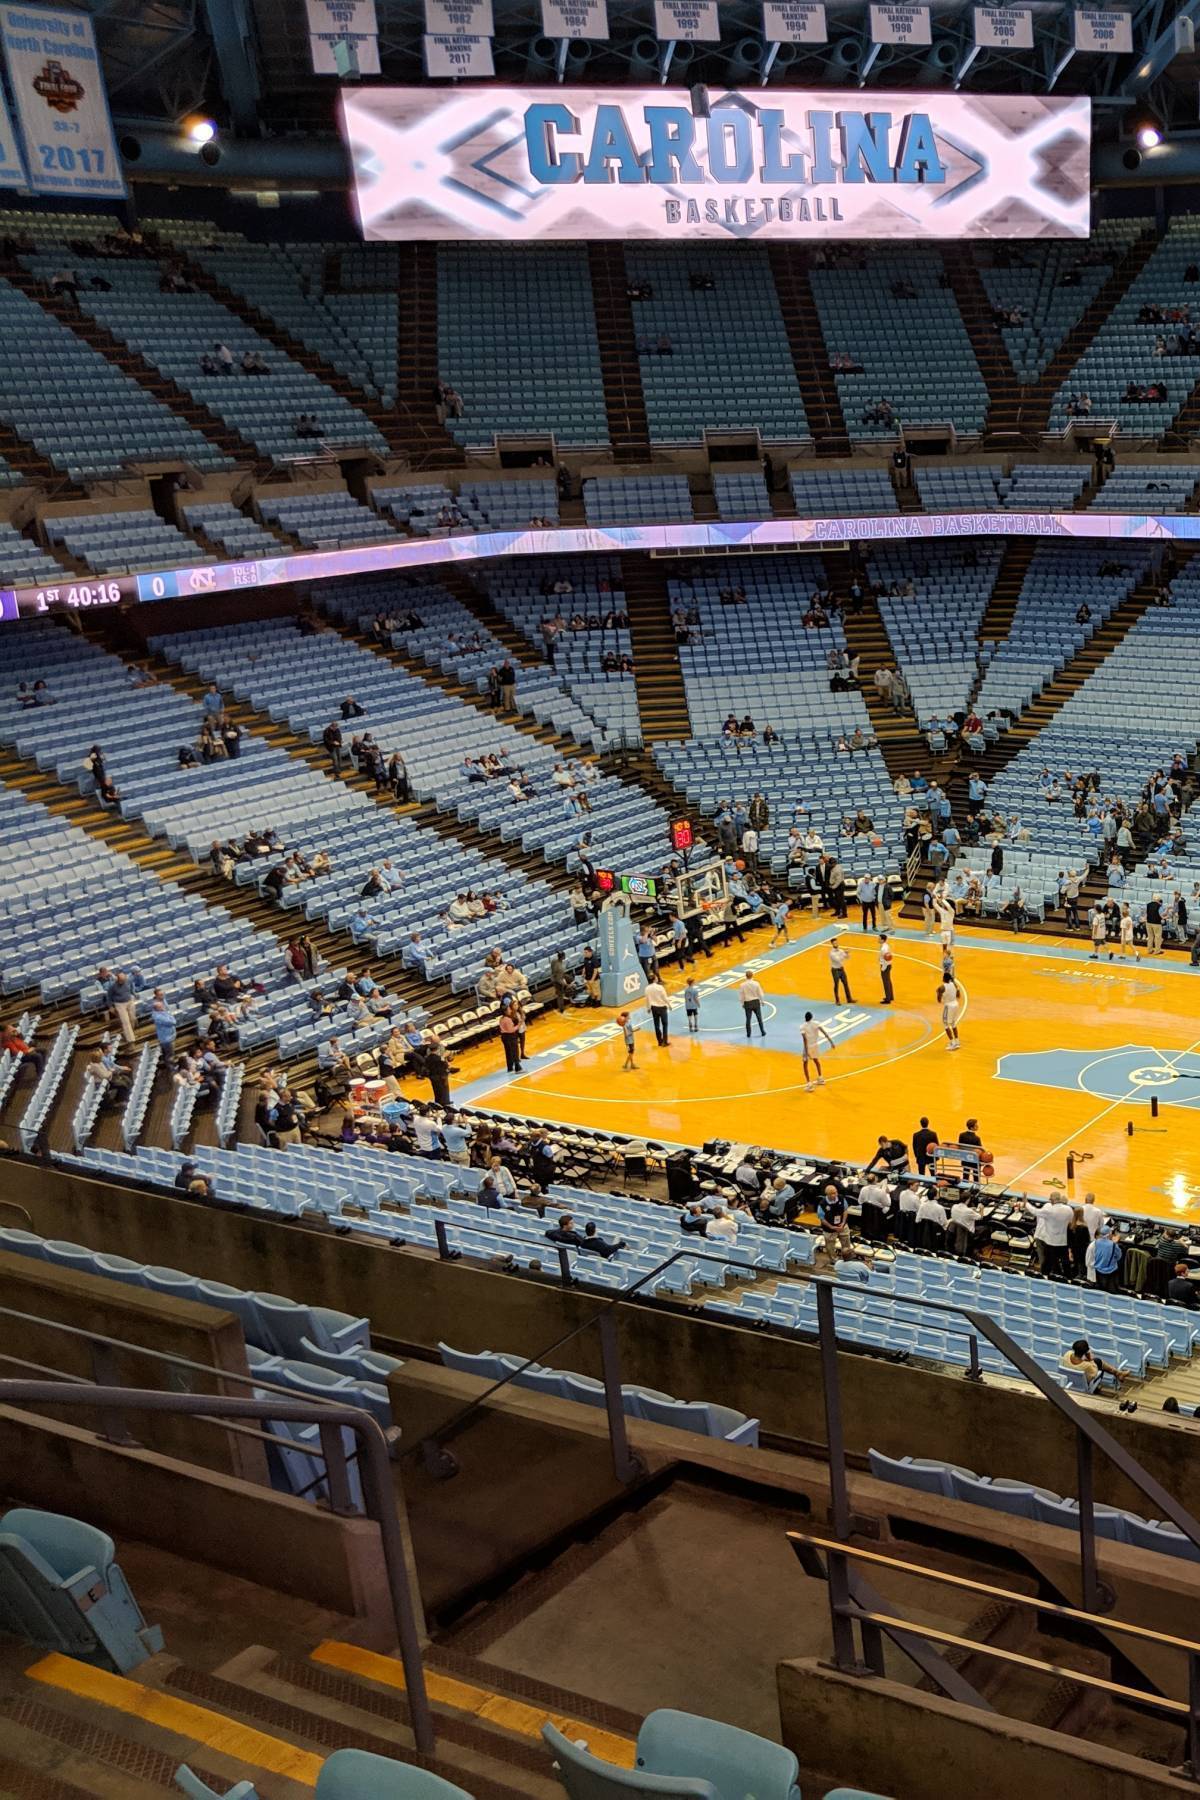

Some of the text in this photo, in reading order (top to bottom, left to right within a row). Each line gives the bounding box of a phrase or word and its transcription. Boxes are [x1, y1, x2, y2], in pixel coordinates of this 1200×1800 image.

[7, 12, 85, 38] University of
[564, 16, 587, 27] 1984
[677, 18, 699, 29] 1993
[785, 21, 807, 32] 1994
[891, 23, 912, 33] 1998
[993, 26, 1015, 37] 2005
[1093, 29, 1114, 39] 2008
[7, 35, 97, 61] North Carolina
[449, 54, 471, 64] 2017
[524, 103, 946, 184] CAROLINA
[39, 144, 105, 173] 2017
[666, 198, 844, 224] BASKETBALL
[815, 516, 1061, 539] CAROLINA BASKETBALL
[152, 577, 165, 597] 0
[36, 583, 121, 612] 1ST 40:16
